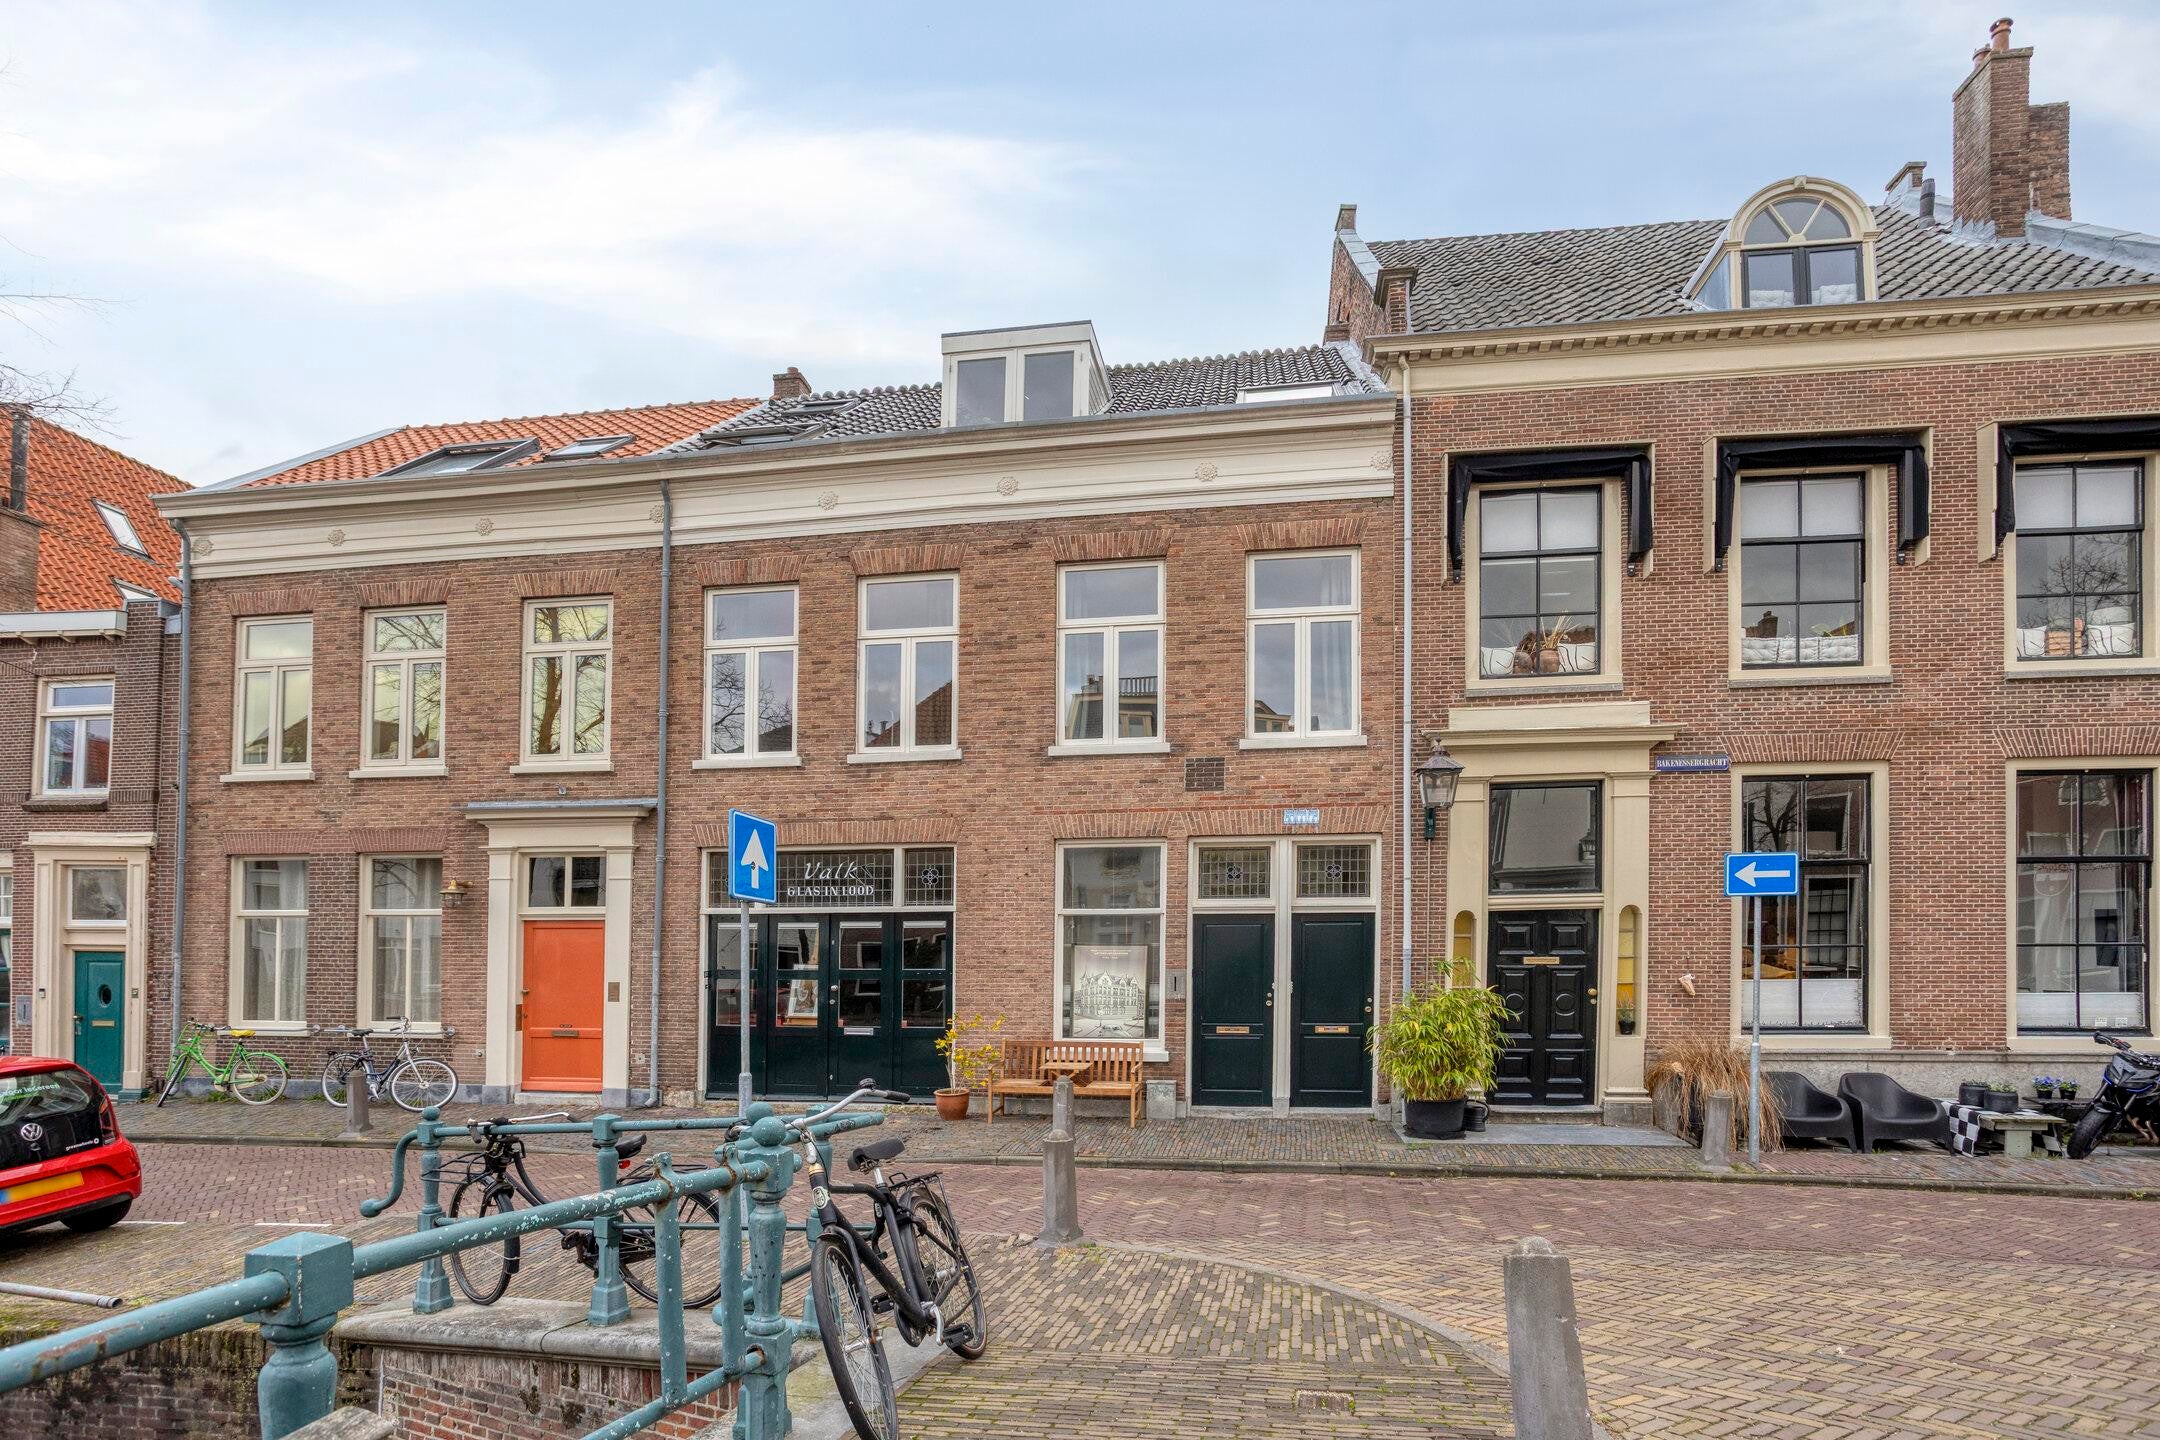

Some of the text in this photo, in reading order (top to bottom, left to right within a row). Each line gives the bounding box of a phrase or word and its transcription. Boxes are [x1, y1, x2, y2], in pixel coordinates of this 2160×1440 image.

[1657, 758, 1727, 767] BAKENESSERGRACHT
[804, 861, 858, 880] Valk
[787, 886, 821, 897] GLAS
[824, 886, 839, 896] IN
